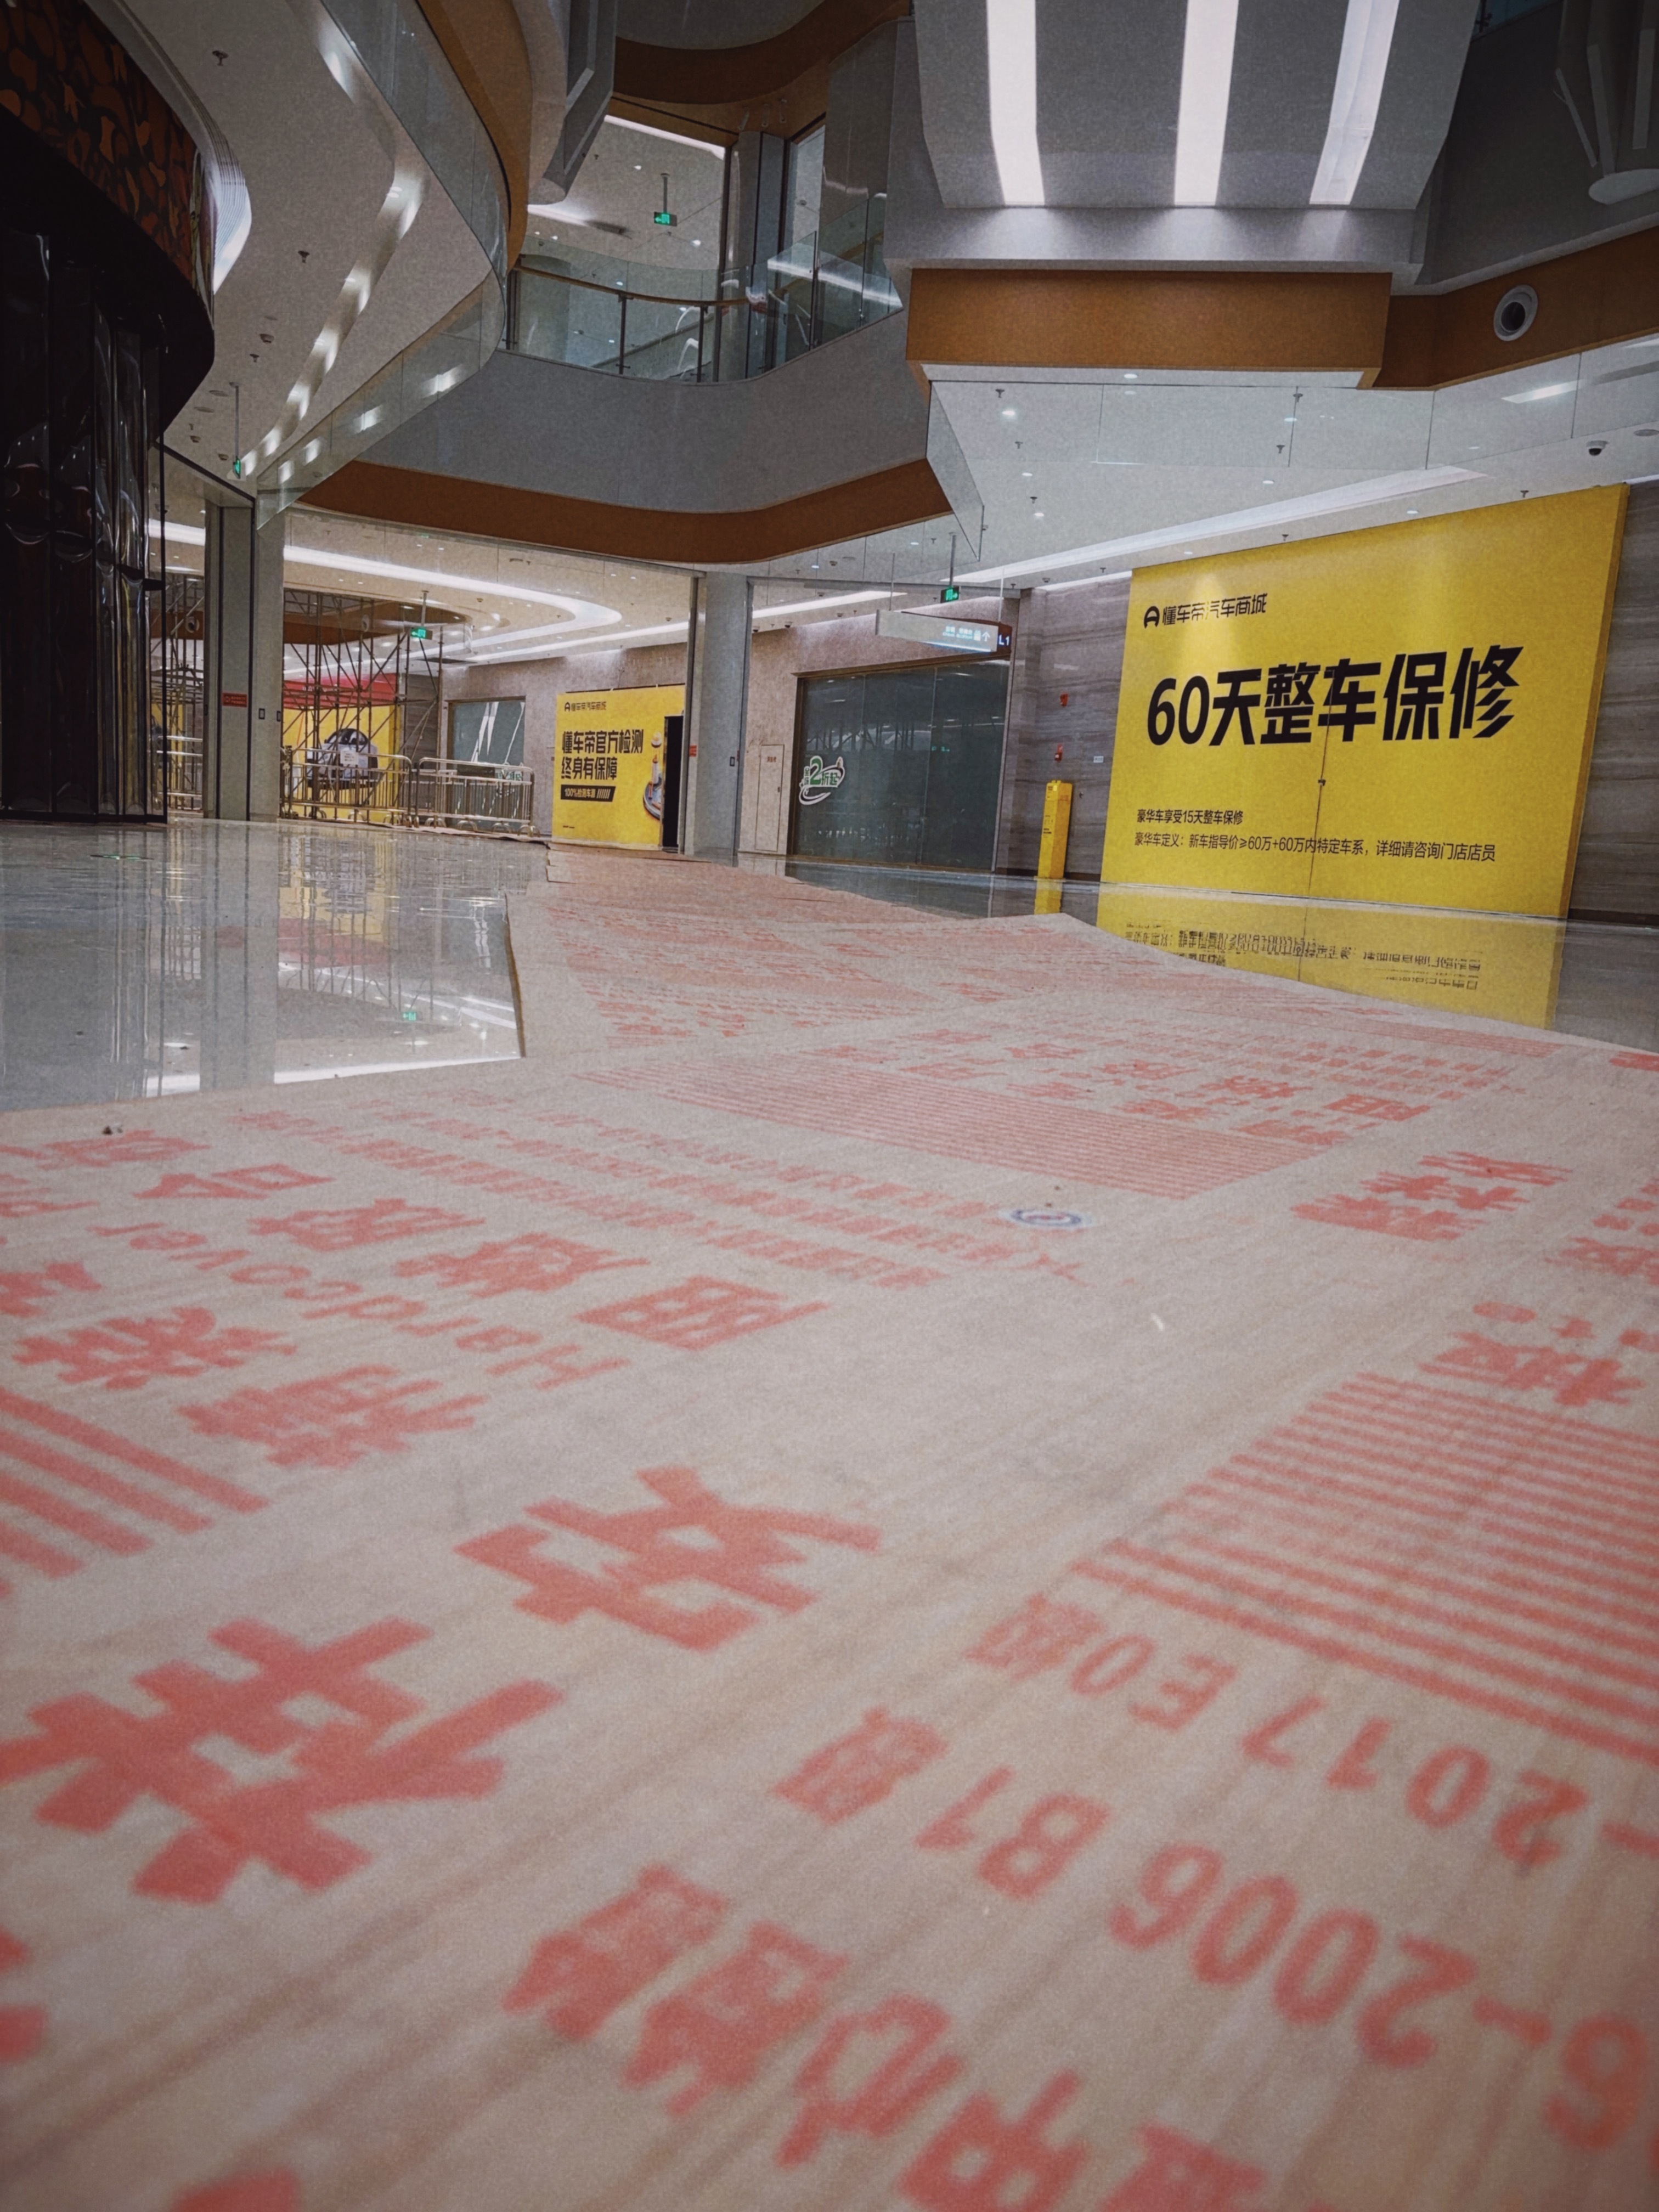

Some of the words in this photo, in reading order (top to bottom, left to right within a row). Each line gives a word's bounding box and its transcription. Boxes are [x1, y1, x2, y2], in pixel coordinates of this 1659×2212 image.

[1163, 593, 1267, 625] 懂车帝汽车商城
[998, 634, 1009, 646] L1
[1148, 645, 1524, 746] 60天整车保修
[562, 729, 644, 754] 懂车帝官方检测
[561, 757, 618, 780] 终身有保障
[1137, 809, 1244, 825] 豪华车享受15天整车保修
[1109, 1845, 1659, 2176] 6-2006
